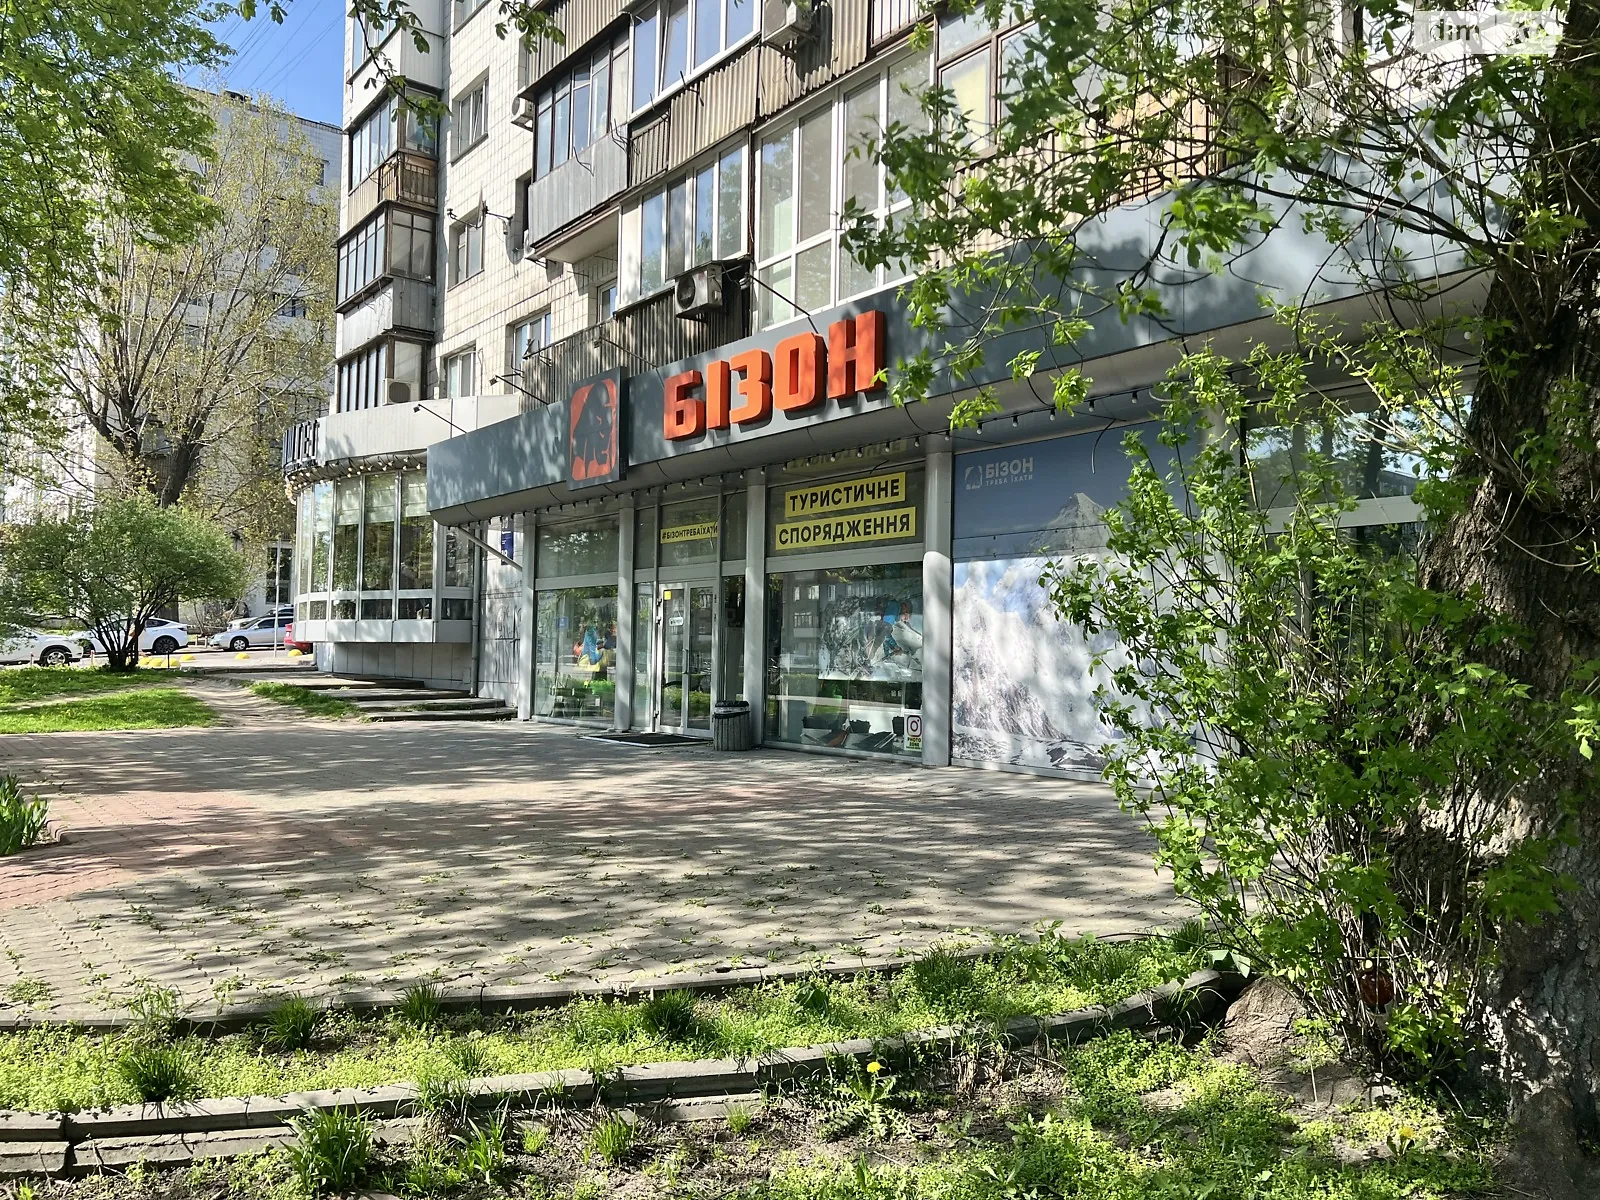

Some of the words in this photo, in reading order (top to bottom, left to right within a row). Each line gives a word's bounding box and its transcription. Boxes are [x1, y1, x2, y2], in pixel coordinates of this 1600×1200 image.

[663, 309, 884, 441] БІЗОН
[985, 457, 1034, 479] БІЗОН
[789, 478, 900, 512] ТУРИСТИЧНЕ
[779, 513, 910, 545] СПОРЯДЖЕННЯ
